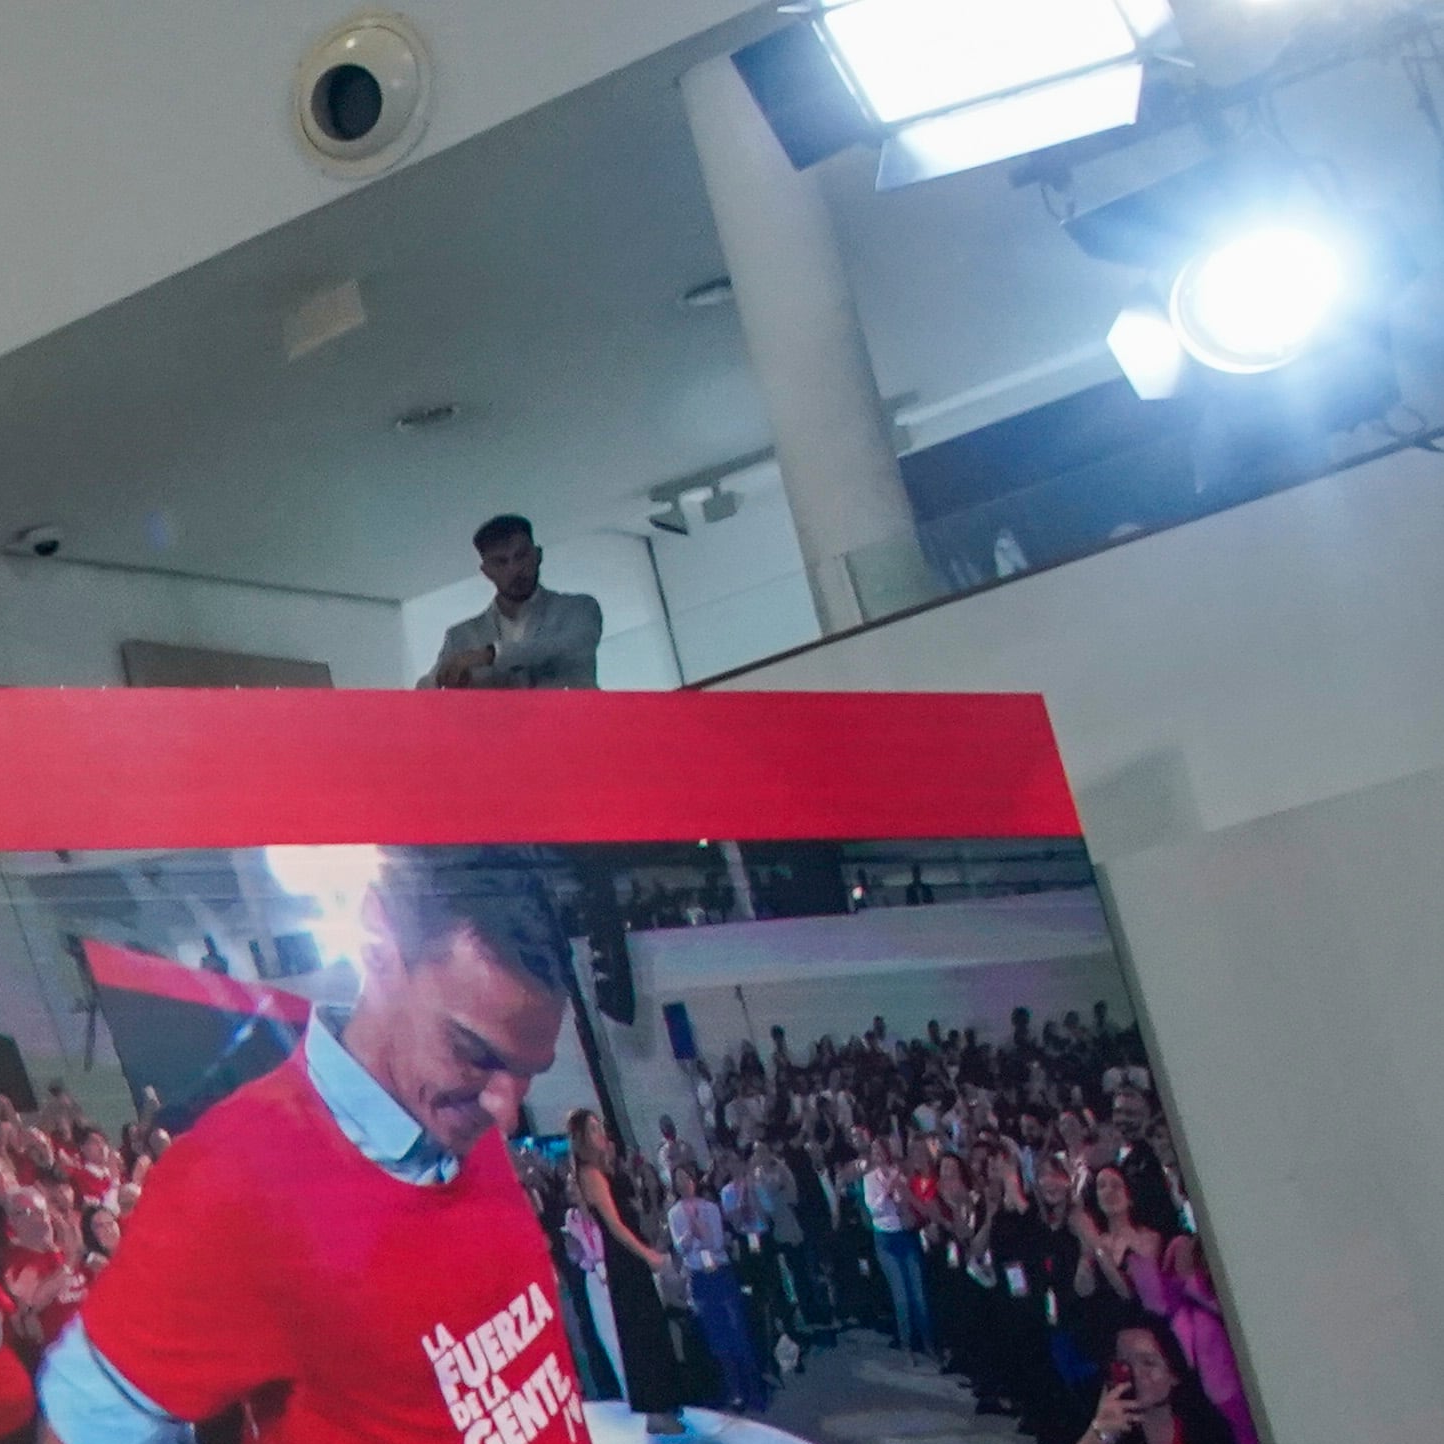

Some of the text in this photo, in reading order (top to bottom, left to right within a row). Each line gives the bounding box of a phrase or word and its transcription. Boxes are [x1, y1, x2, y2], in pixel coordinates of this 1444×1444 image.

[421, 1323, 456, 1363] LA
[434, 1282, 554, 1406] FUERZA
[478, 1374, 510, 1411] LA
